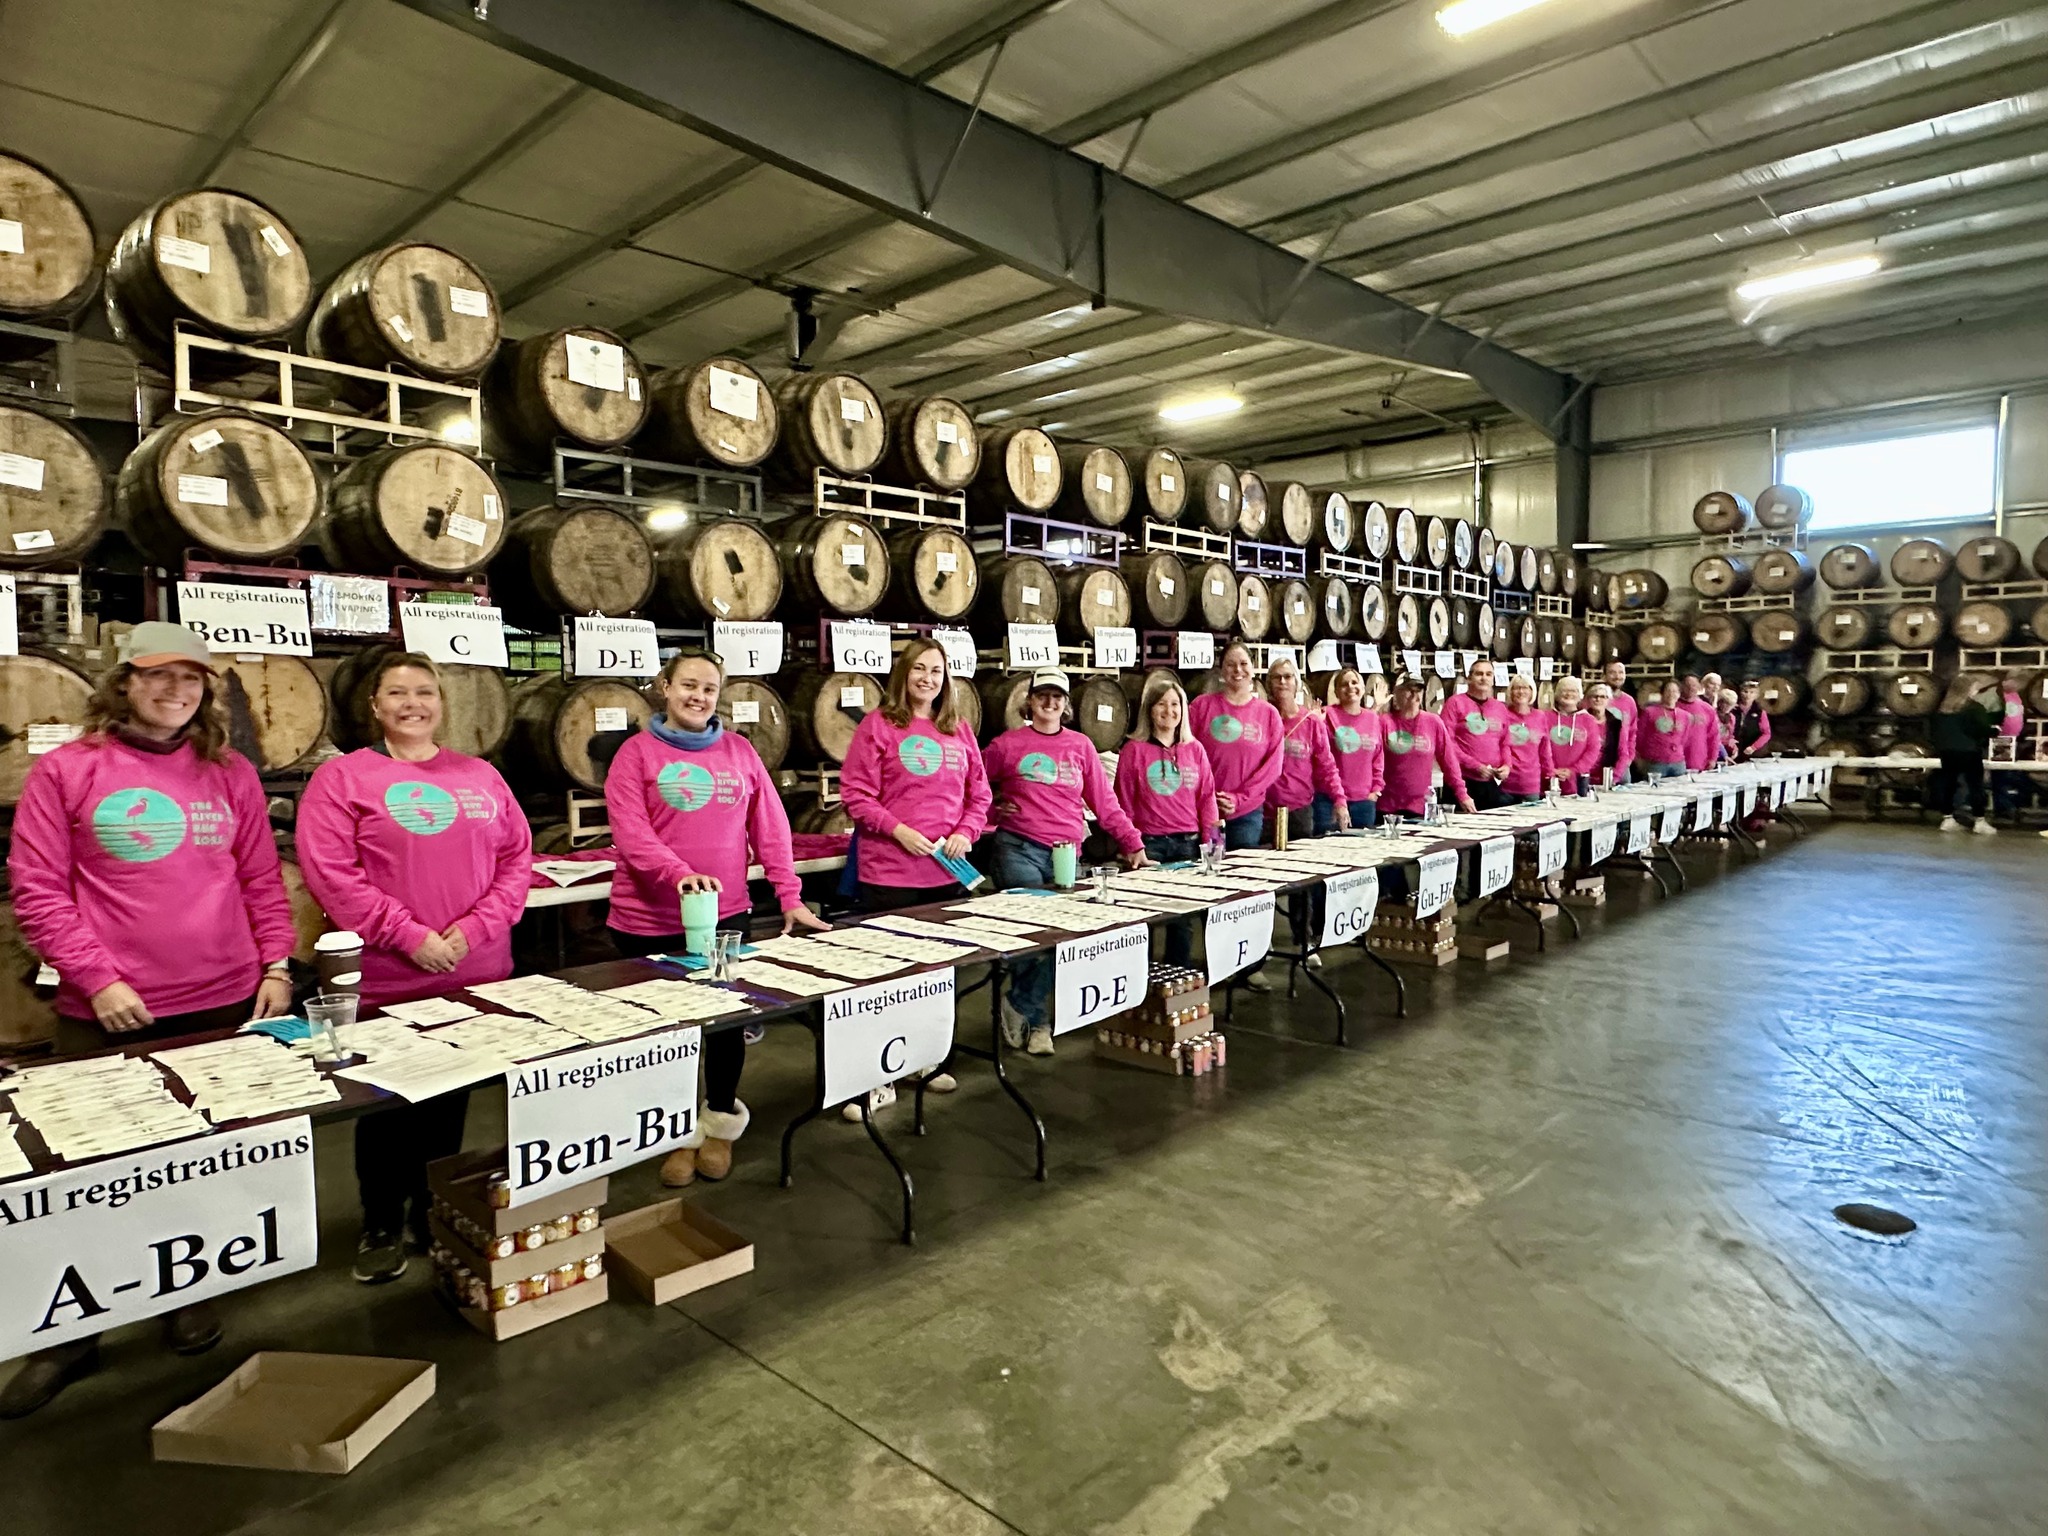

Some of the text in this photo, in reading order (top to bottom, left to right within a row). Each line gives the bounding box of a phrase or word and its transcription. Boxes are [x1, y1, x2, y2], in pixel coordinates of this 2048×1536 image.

[182, 587, 205, 599] All
[210, 590, 306, 604] registrations
[403, 607, 501, 621] All registrations
[185, 621, 309, 647] Ben-Bu
[578, 622, 655, 635] All registrations
[716, 625, 782, 637] All registrations
[834, 626, 889, 637] All registrations
[449, 634, 471, 655] C
[1019, 646, 1050, 661] Ho-I
[598, 649, 644, 669] D-E
[748, 650, 759, 668] F
[844, 648, 884, 667] G-Gr
[1182, 651, 1211, 664] Kn-La
[1327, 875, 1377, 895] All registrations
[1421, 881, 1452, 910] Gu-Hi
[1208, 900, 1274, 925] All registrations
[1334, 906, 1369, 936] G-Gr
[1058, 933, 1147, 965] All registrations
[1236, 939, 1248, 967] F
[827, 979, 953, 1021] All registrations
[1078, 974, 1127, 1017] D-E
[880, 1036, 906, 1073] C
[512, 1068, 551, 1098] All
[557, 1041, 699, 1088] registrations
[515, 1106, 693, 1190] Ben-Bu
[0, 1135, 309, 1226] All registrations
[32, 1206, 284, 1333] A-Bel
